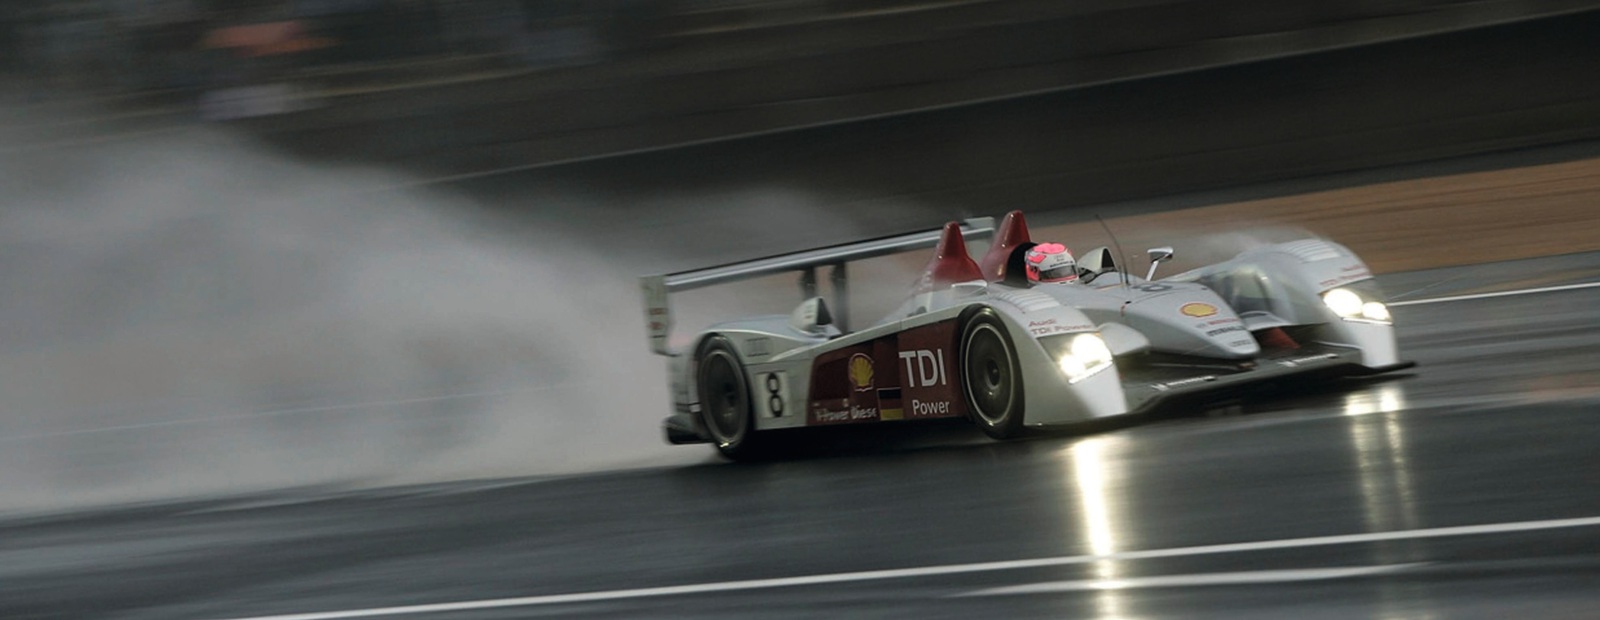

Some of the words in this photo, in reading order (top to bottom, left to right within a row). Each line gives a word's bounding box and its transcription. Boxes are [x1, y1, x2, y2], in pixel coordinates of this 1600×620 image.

[899, 348, 947, 388] TDI
[766, 372, 783, 418] 8
[912, 399, 950, 415] Power
